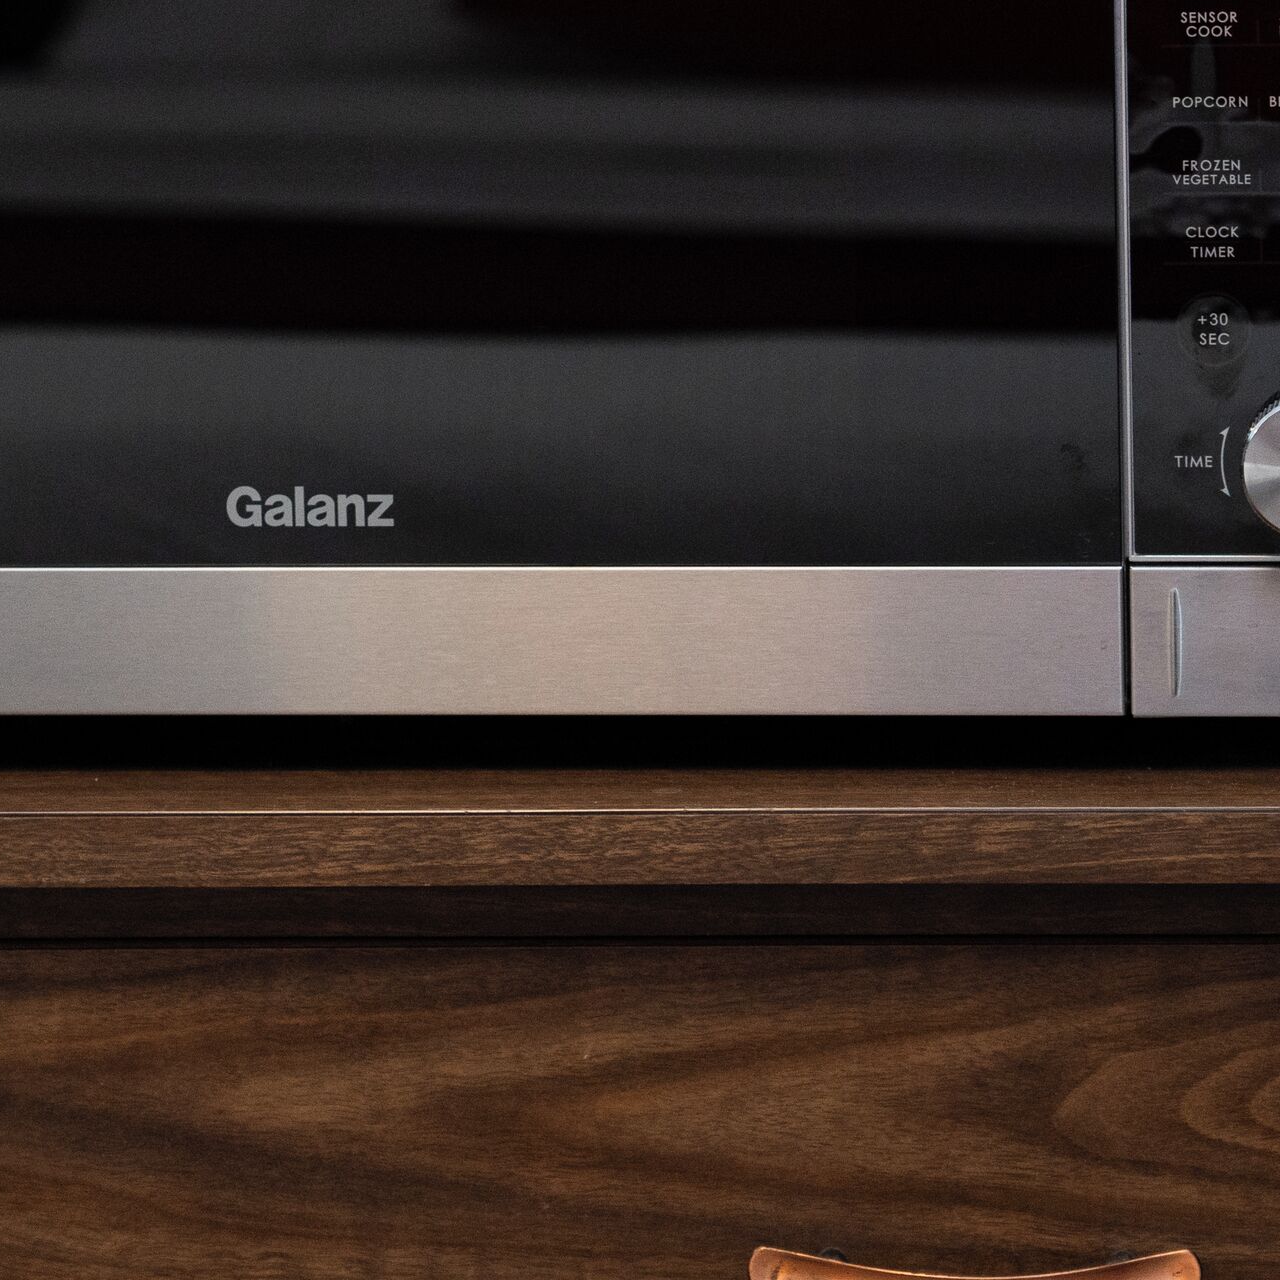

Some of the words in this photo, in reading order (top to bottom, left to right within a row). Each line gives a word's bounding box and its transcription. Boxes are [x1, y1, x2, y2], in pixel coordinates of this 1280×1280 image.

[1180, 11, 1238, 24] SENSOR
[1185, 25, 1233, 38] COOK
[1172, 96, 1249, 109] POPCORN
[1182, 160, 1241, 172] FROZEN
[1172, 174, 1252, 186] VEGETABLE
[1185, 226, 1239, 239] CLOCK
[1190, 246, 1236, 259] TIMER
[1197, 312, 1229, 327] +30
[1199, 333, 1230, 346] SEC
[1174, 455, 1213, 469] TIME
[225, 485, 396, 528] Galanz
